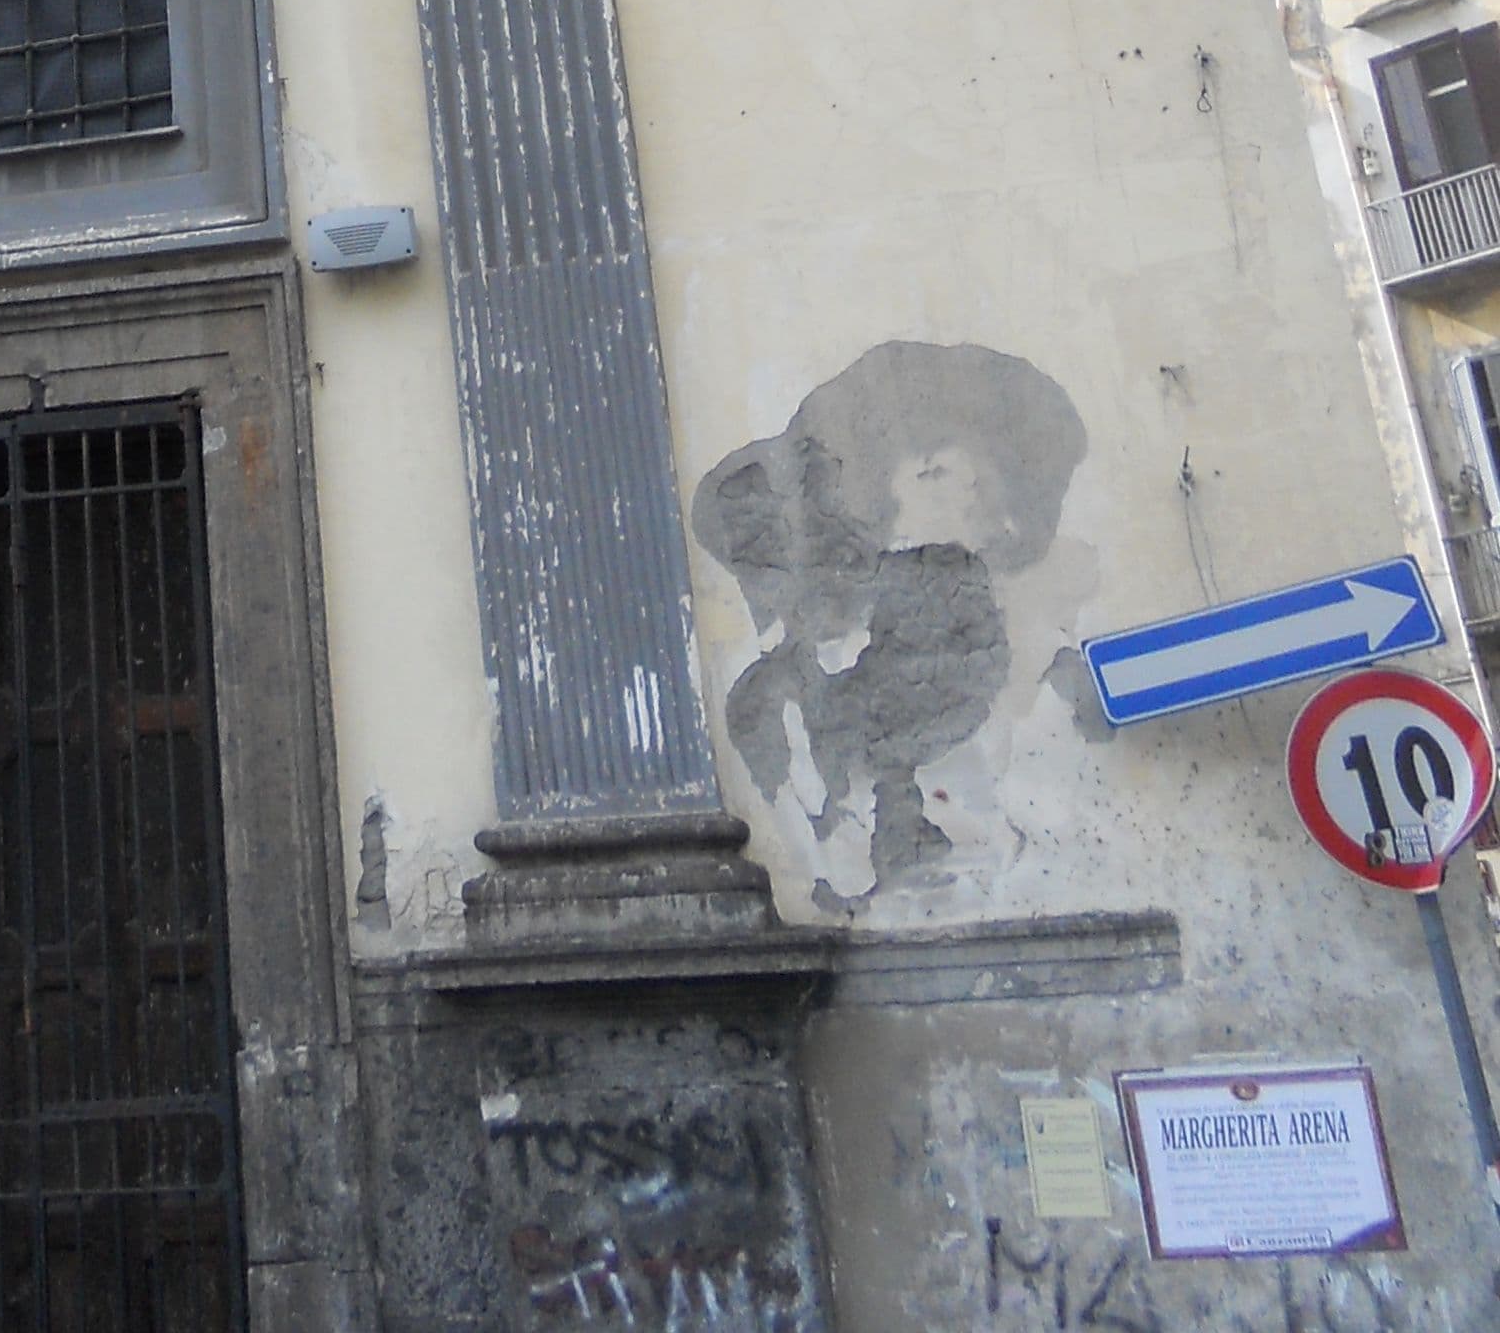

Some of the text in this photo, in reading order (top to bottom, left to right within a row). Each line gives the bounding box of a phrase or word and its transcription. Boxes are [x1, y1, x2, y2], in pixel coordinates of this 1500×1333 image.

[1342, 726, 1455, 830] 10
[1161, 1111, 1350, 1150] MARGHERITA ARENA
